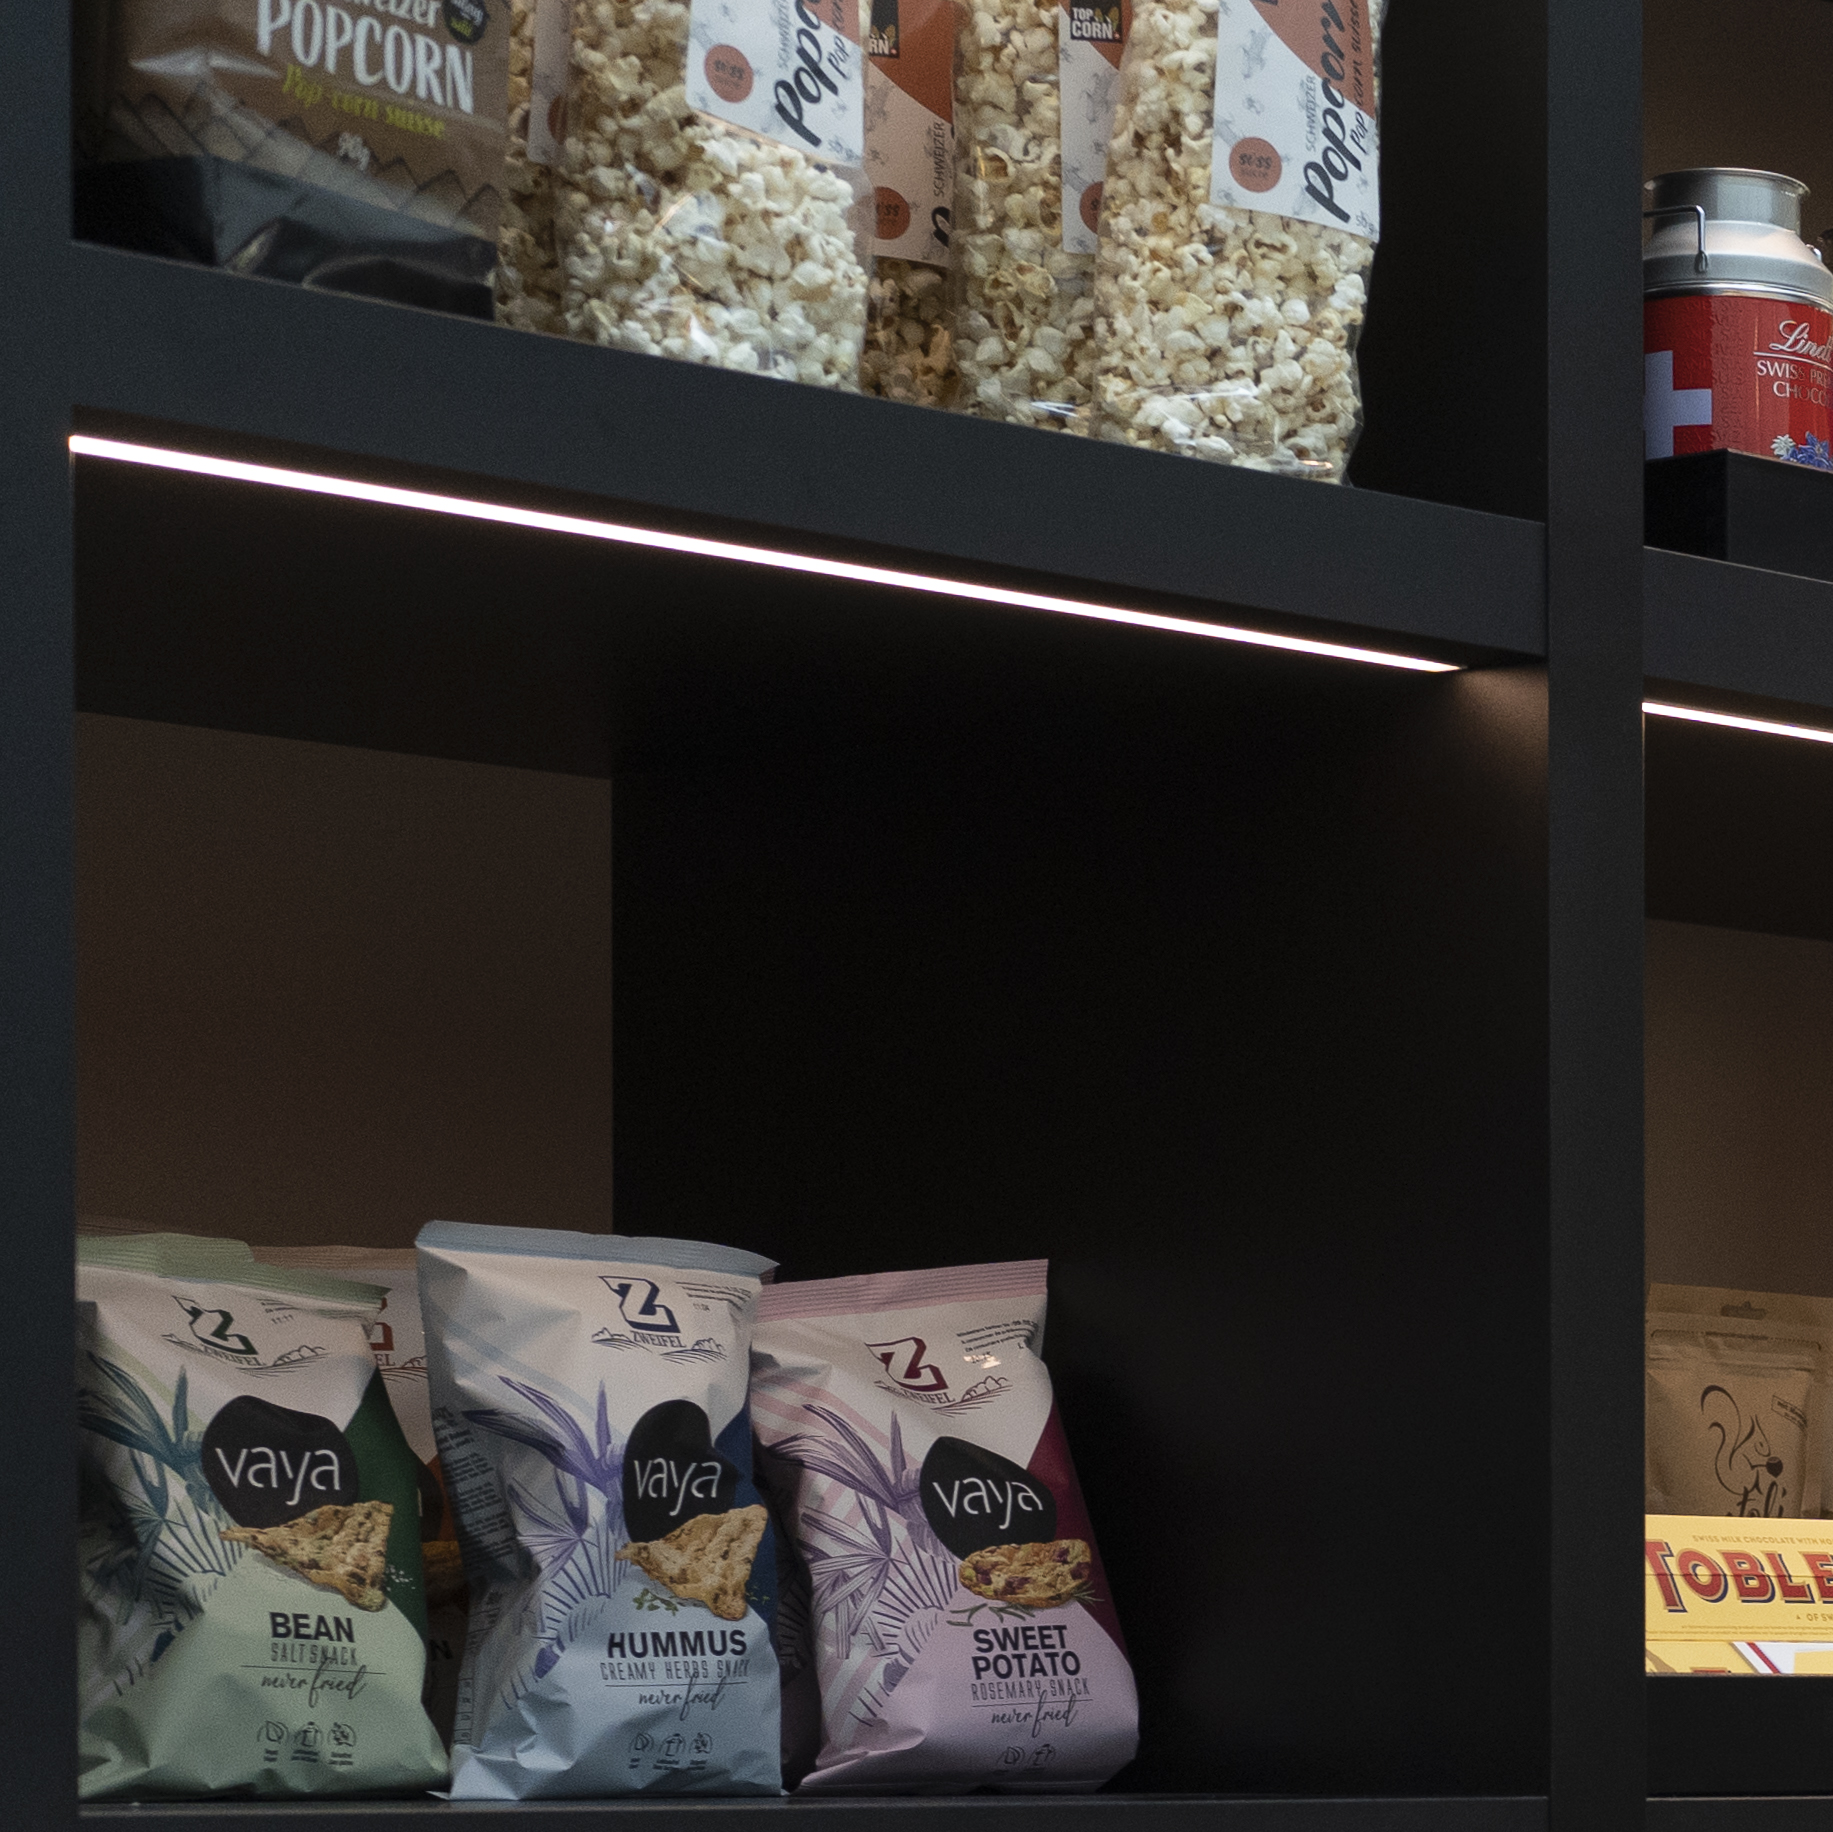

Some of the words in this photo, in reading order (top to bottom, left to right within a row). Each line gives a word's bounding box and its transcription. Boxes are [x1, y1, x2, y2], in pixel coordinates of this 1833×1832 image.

[1072, 7, 1088, 22] TOP
[1071, 19, 1113, 40] CORN
[257, 0, 474, 115] POPCORN
[1757, 360, 1806, 381] SWISS
[630, 1330, 687, 1348] ZWEIFEL
[215, 1447, 340, 1505] vaya
[634, 1458, 722, 1516] vaya
[932, 1477, 1043, 1530] vaya
[1743, 1536, 1796, 1546] CHOCOLATE
[270, 1612, 355, 1643] BEAN
[1807, 1613, 1820, 1622] OF
[608, 1630, 747, 1658] HUMMUS
[973, 1625, 1067, 1653] SWEET
[271, 1643, 306, 1664] SALT
[972, 1651, 1080, 1680] POTATO
[261, 1672, 308, 1689] never
[308, 1655, 367, 1708] fried
[601, 1662, 656, 1681] CREAMY
[665, 1660, 709, 1680] HERBS
[639, 1690, 682, 1705] never
[680, 1675, 726, 1721] fried
[971, 1681, 1042, 1701] ROSEMARY
[1050, 1677, 1090, 1697] SNACK
[991, 1709, 1032, 1724] never
[1032, 1690, 1078, 1738] fried
